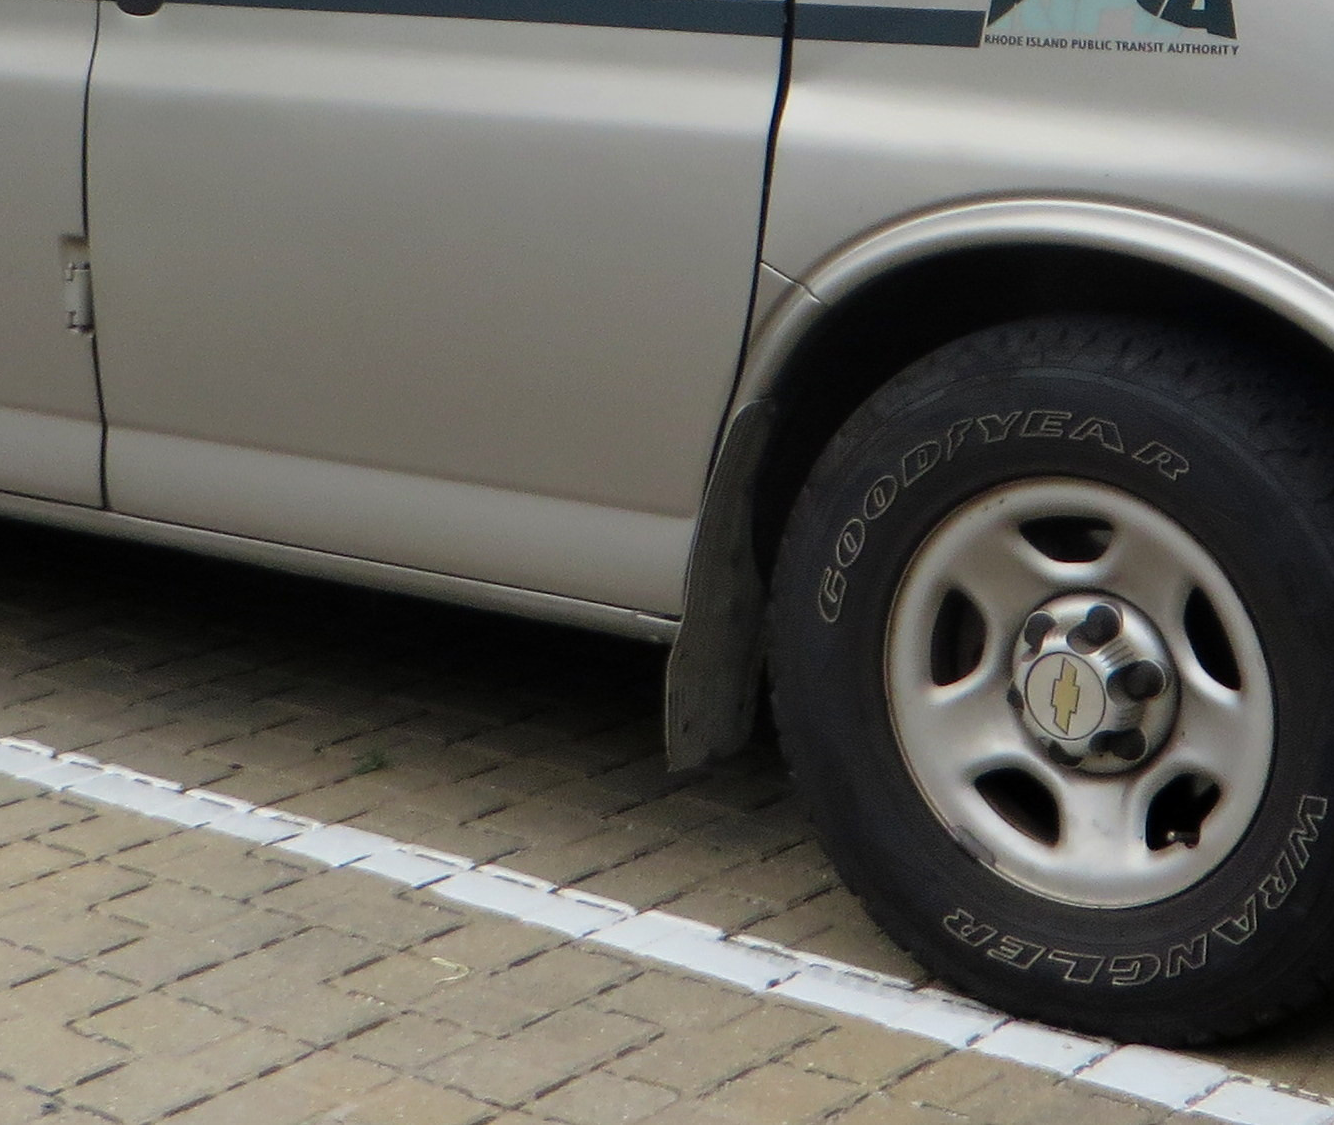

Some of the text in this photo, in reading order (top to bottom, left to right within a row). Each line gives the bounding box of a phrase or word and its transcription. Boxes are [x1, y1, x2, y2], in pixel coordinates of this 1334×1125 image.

[984, 33, 1240, 56] RHODE ISLAND PUBLIC TRANSIT AUTHORITY
[818, 410, 1191, 623] GOODYEAR
[942, 794, 1329, 986] WRANGLER
